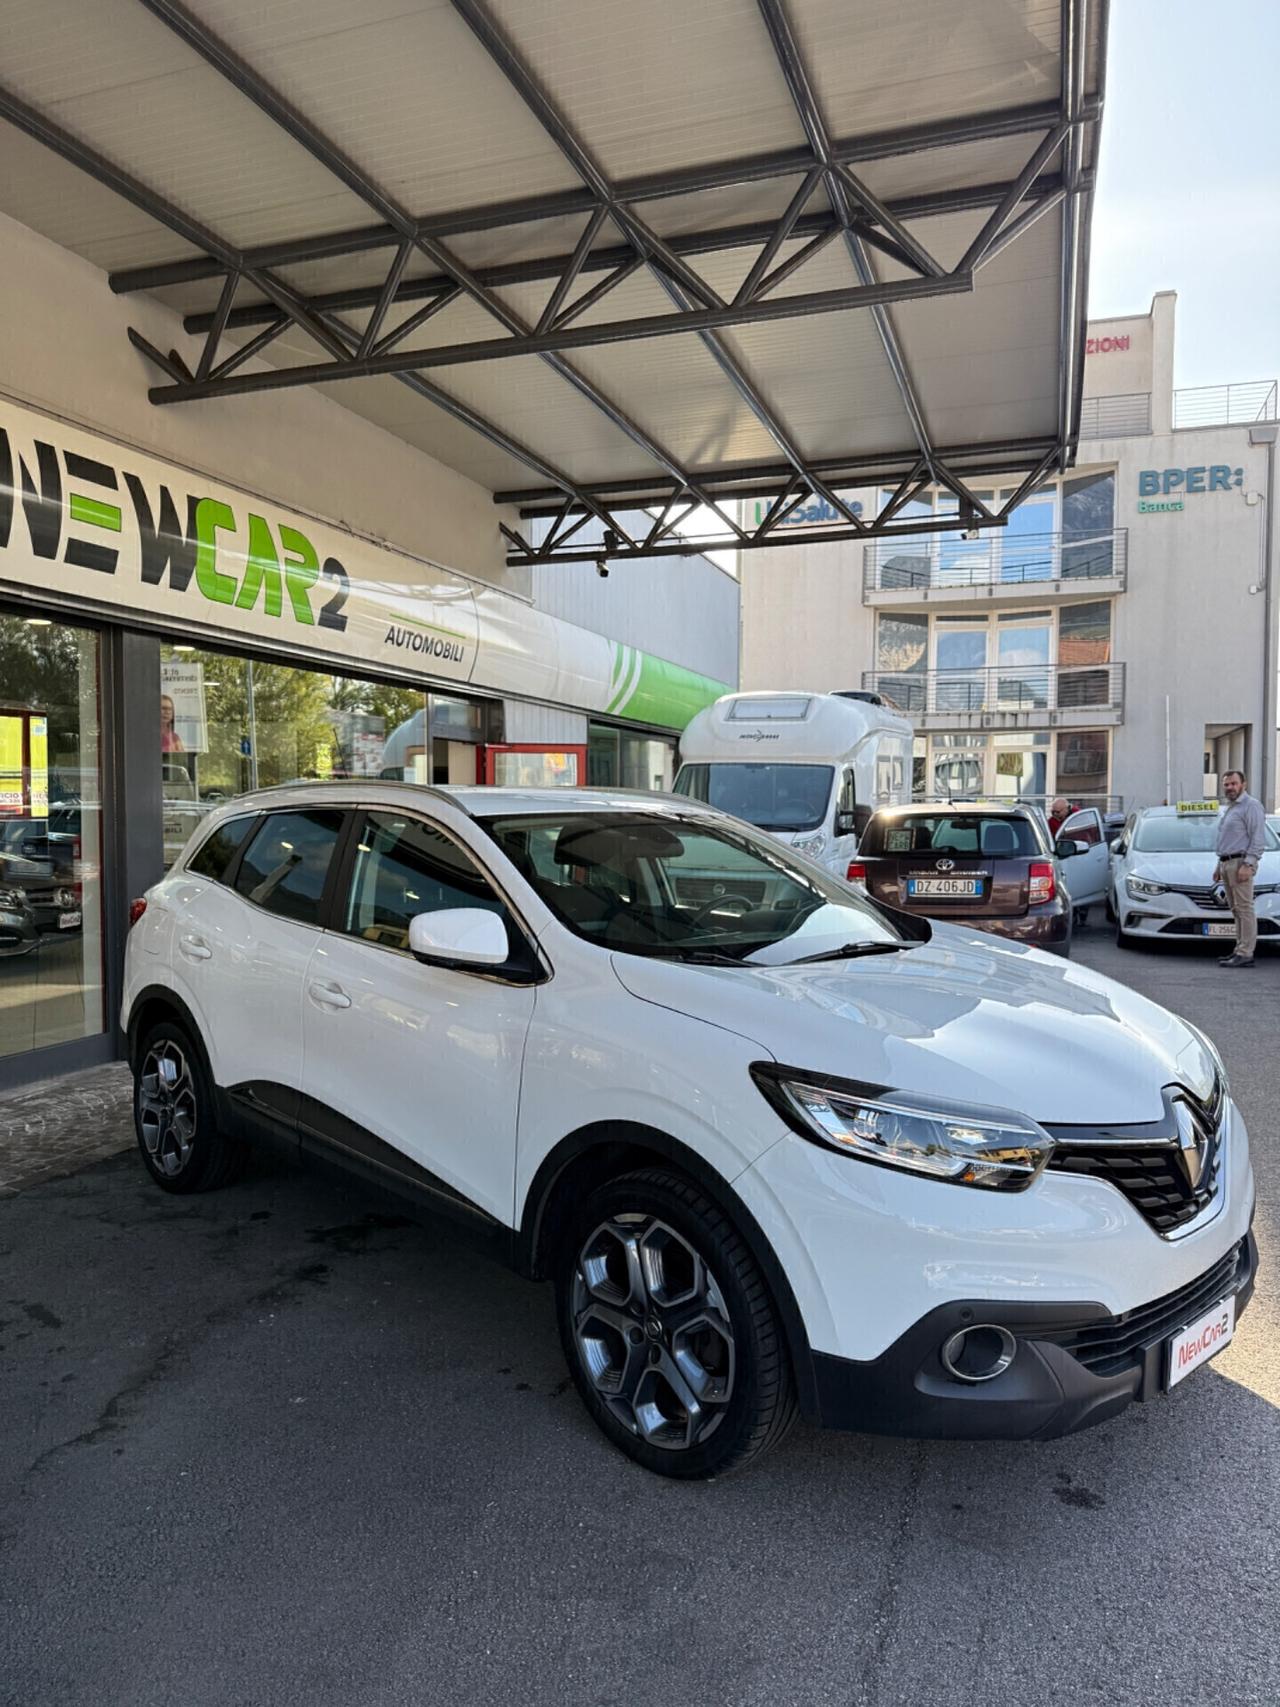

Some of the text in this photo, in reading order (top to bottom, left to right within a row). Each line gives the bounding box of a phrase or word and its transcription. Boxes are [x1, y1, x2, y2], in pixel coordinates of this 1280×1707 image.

[1138, 501, 1185, 513] Banca
[385, 625, 465, 663] AUTOMOBILI
[1181, 802, 1215, 812] DIESEL
[917, 881, 974, 893] DZ 406JD
